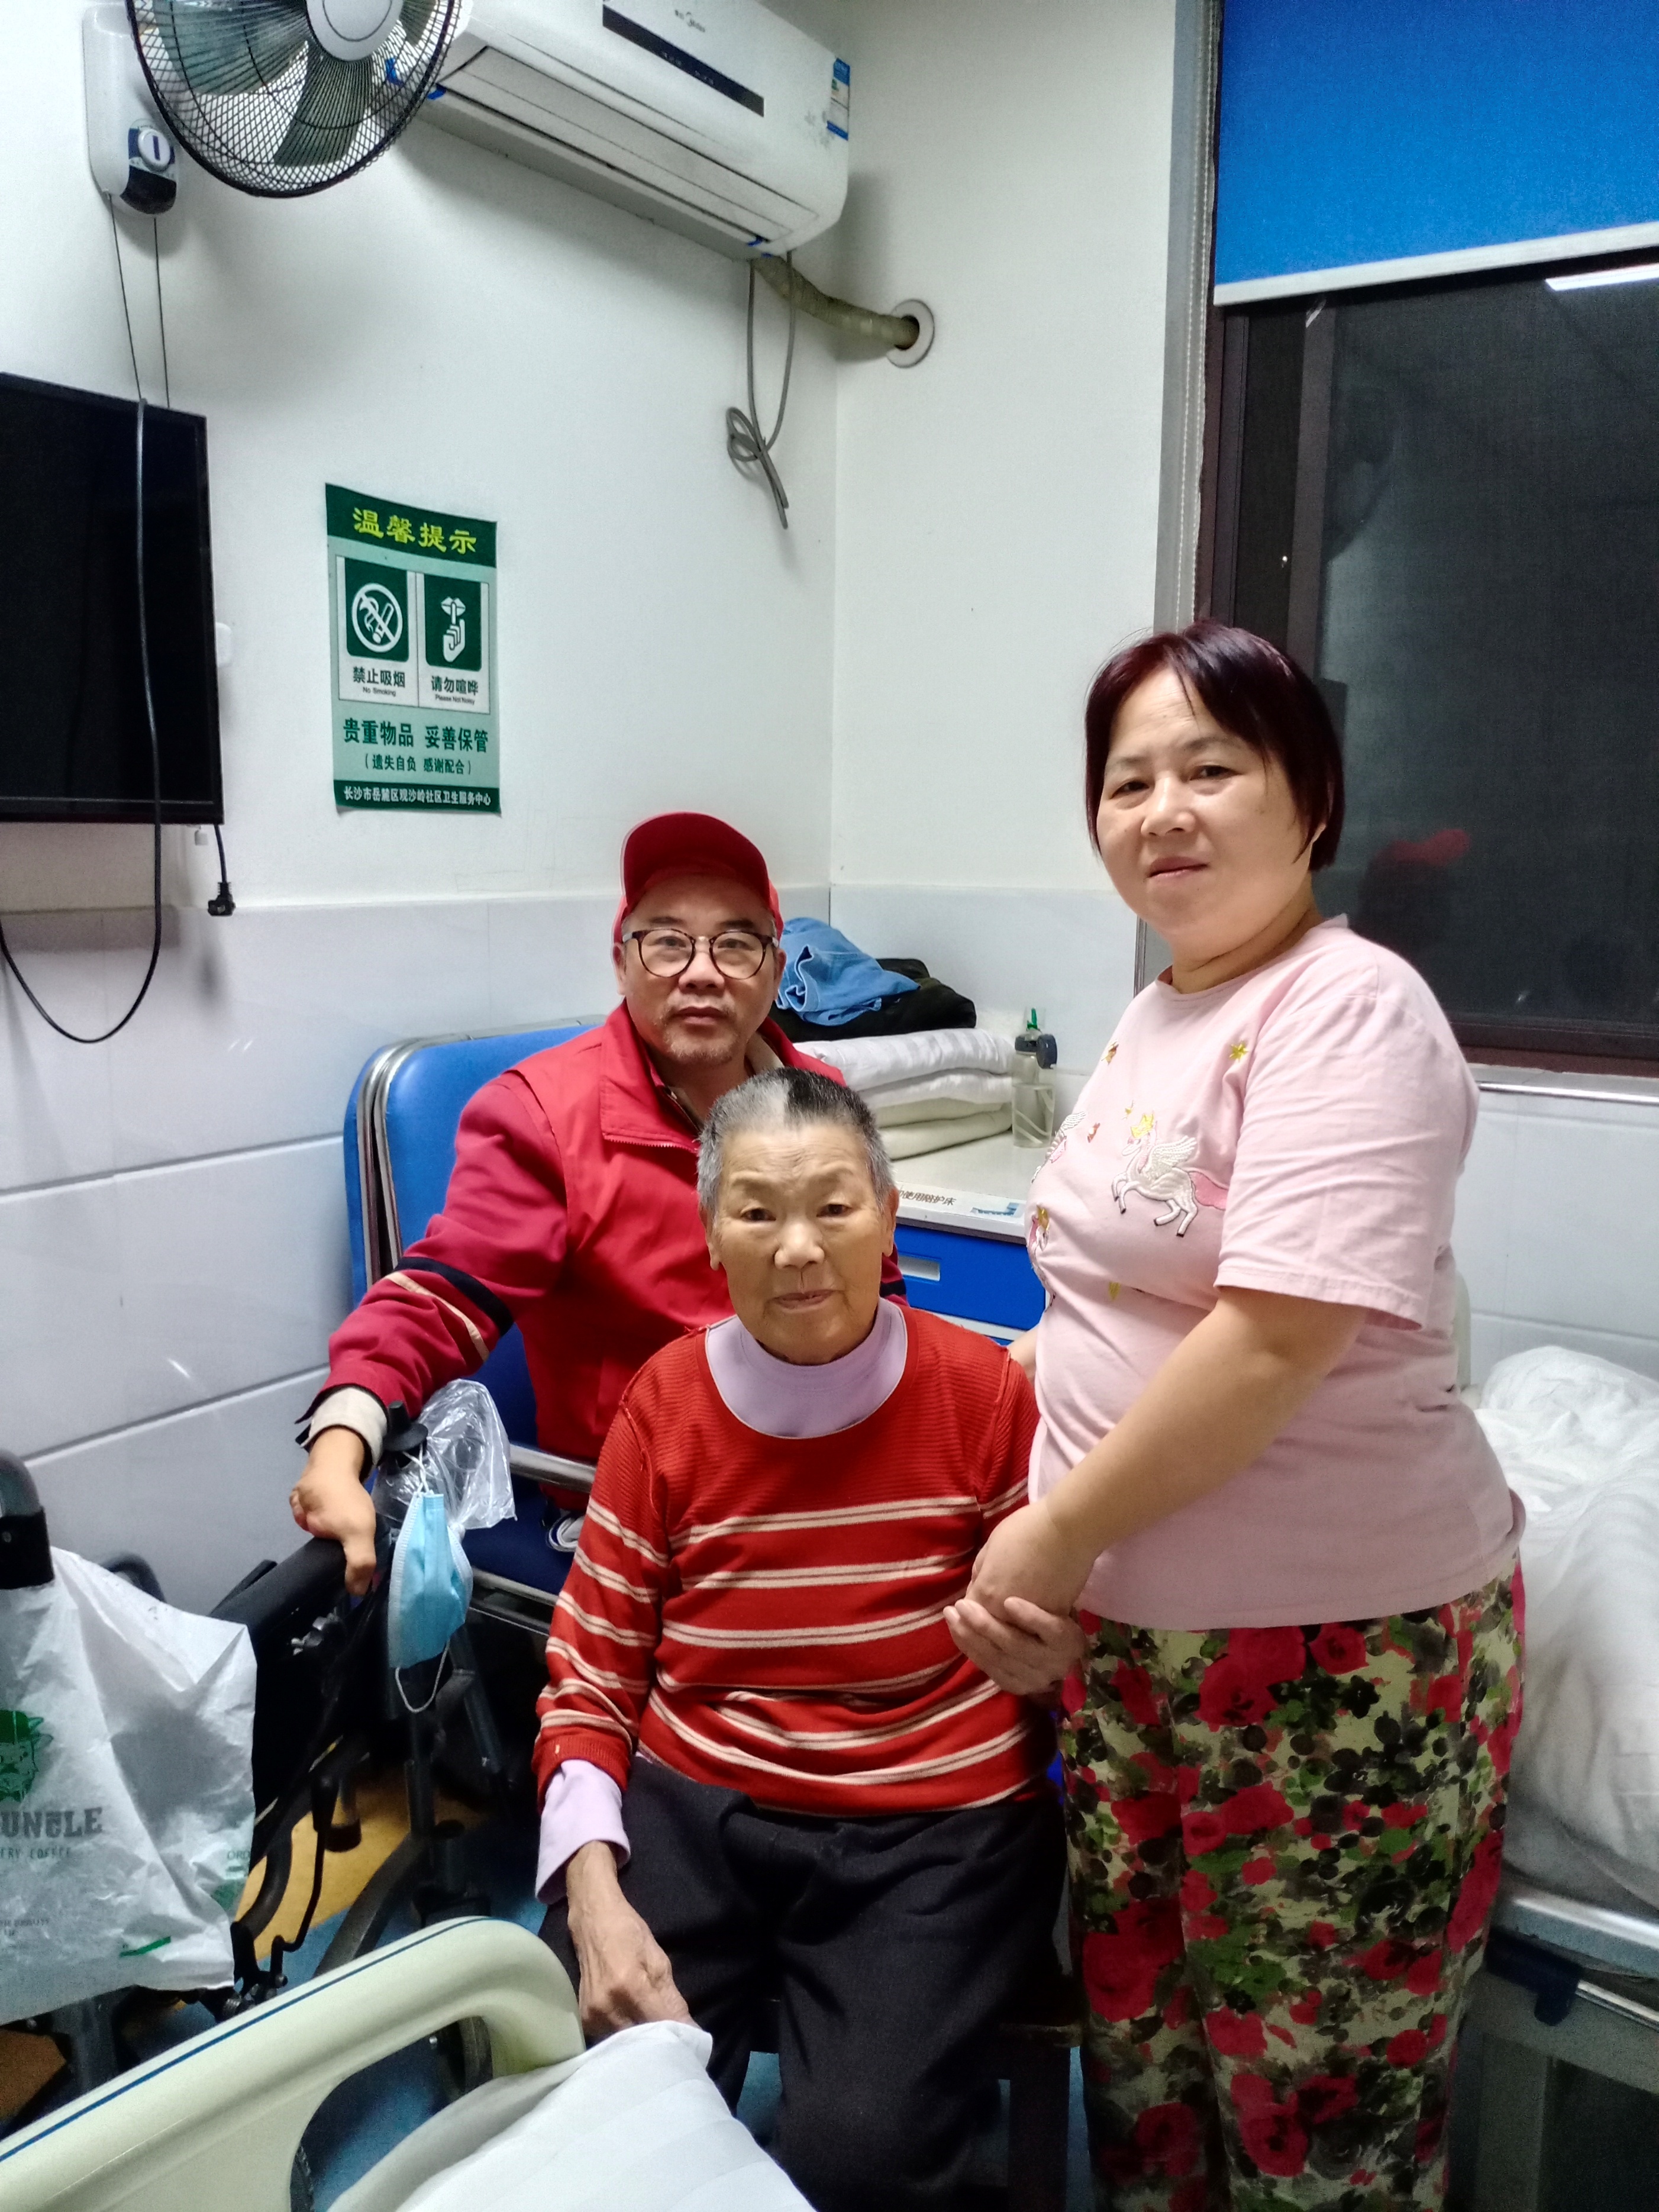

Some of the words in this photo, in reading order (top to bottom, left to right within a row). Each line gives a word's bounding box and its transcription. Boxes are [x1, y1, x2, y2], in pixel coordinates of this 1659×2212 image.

[353, 507, 476, 554] 温馨提示
[353, 666, 405, 688] 禁止吸烟
[431, 675, 479, 696] 请勿喧哗
[373, 688, 396, 697] Smoking
[435, 694, 452, 702] Please
[462, 697, 475, 705] Noisy
[344, 718, 414, 747] 贵重物品
[425, 725, 489, 753] 妥善保管
[344, 785, 491, 806] 长沙市岳麓区观沙岭社区卫生服务中心
[227, 1850, 251, 1860] ORD
